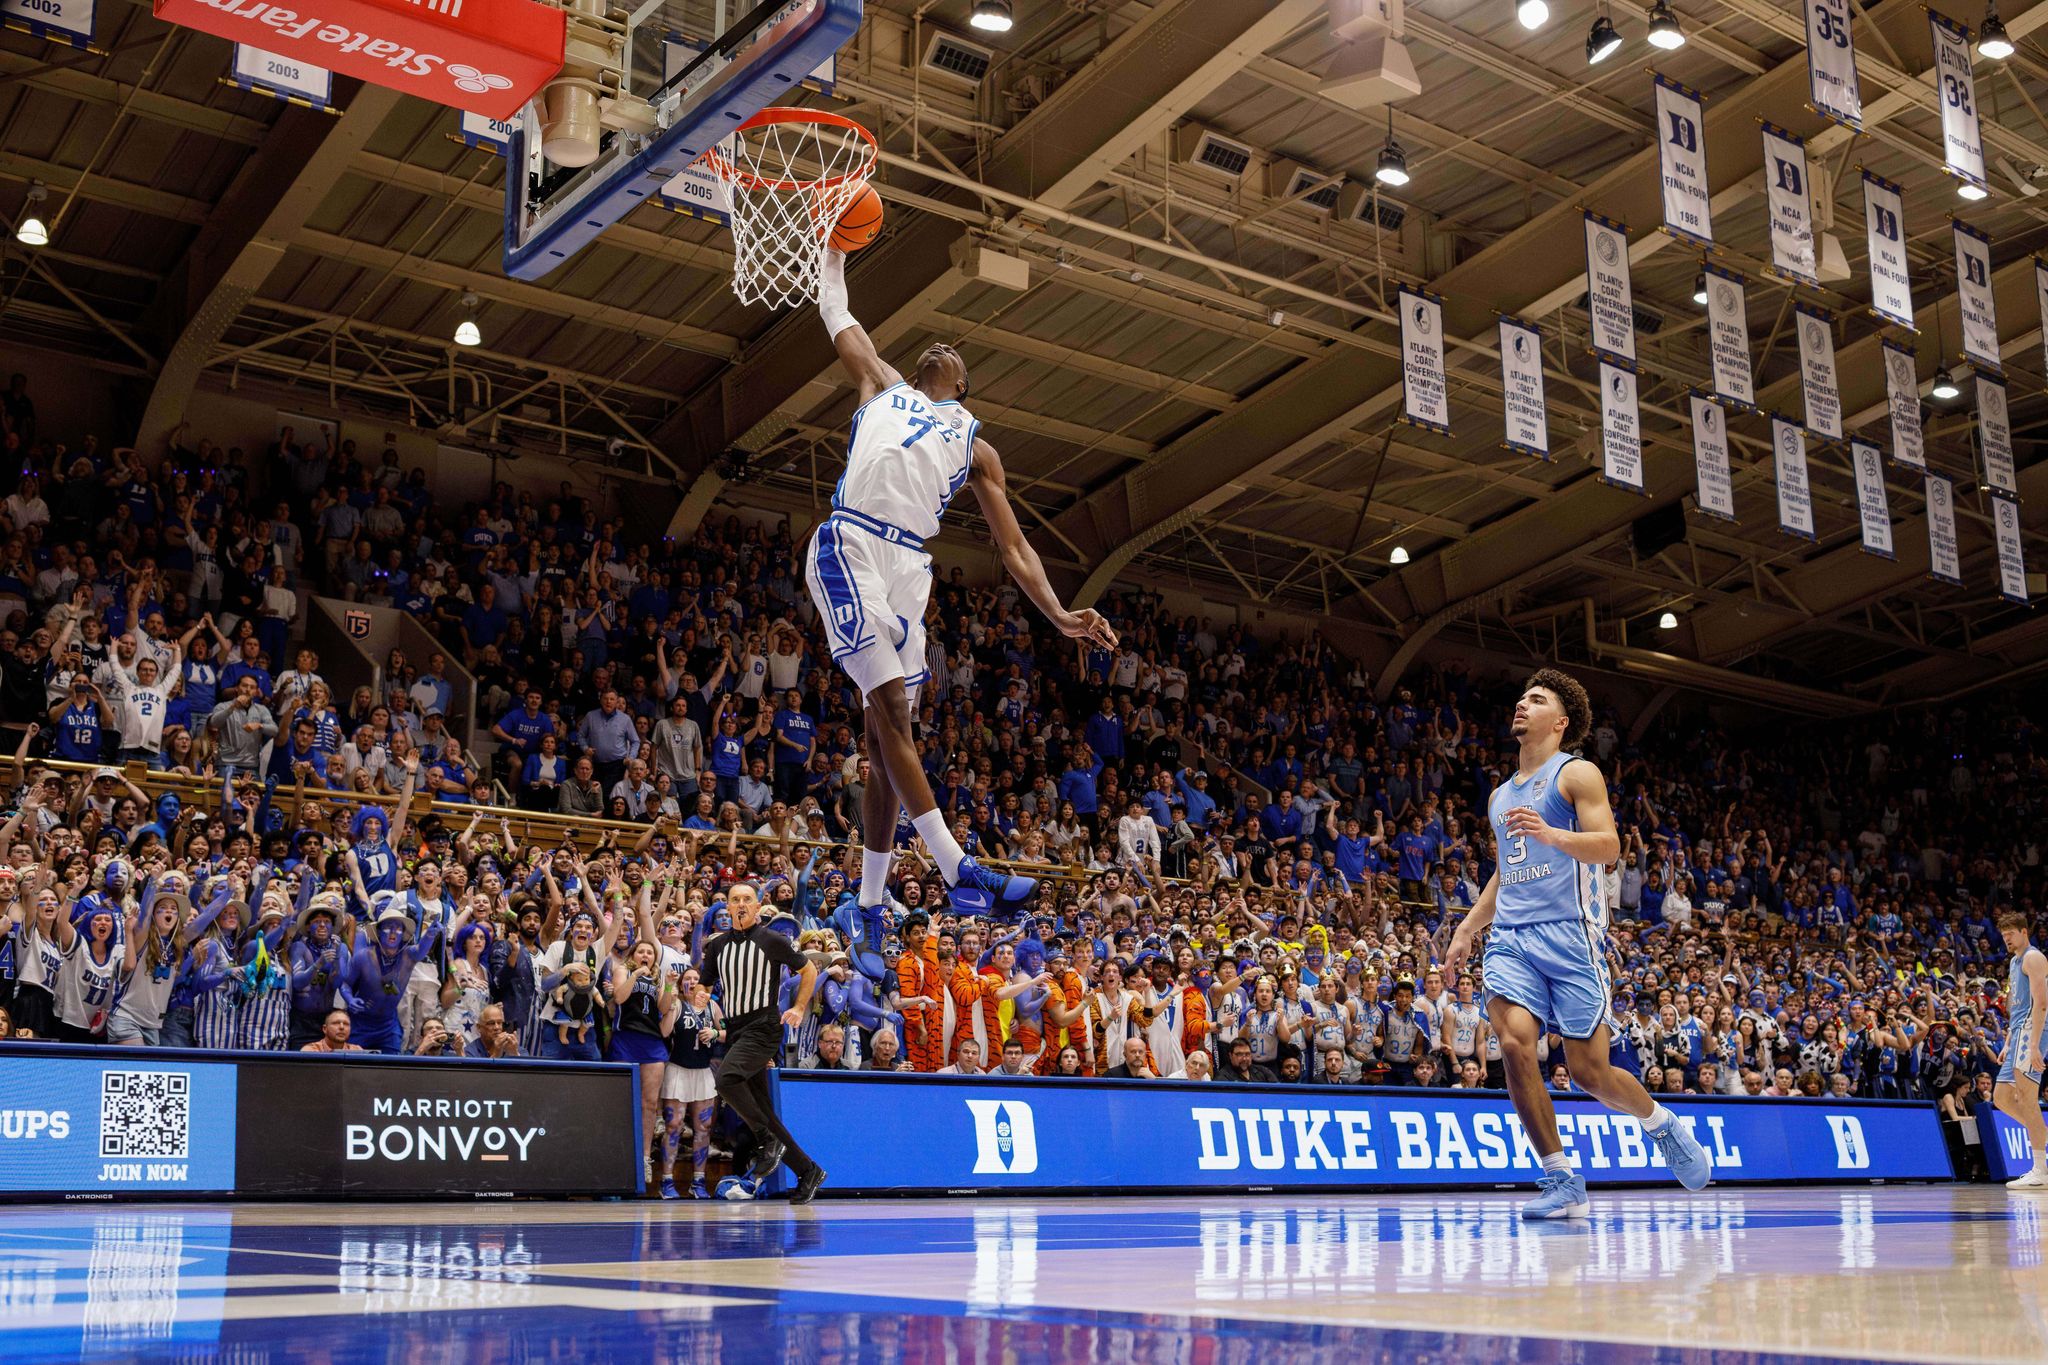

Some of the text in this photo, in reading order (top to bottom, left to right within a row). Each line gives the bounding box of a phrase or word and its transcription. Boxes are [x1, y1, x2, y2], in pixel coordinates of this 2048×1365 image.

[20, 0, 62, 17] 2002
[1815, 4, 1848, 48] 35
[268, 61, 300, 80] 2003
[1944, 74, 1972, 116] 32
[489, 118, 519, 136] 200
[1667, 110, 1696, 152] D
[1676, 162, 1696, 178] NCAA
[1773, 156, 1802, 195] D
[684, 182, 712, 200] 2005
[1665, 176, 1707, 201] FINAL FOUR
[1680, 210, 1698, 226] 1988
[1782, 206, 1802, 220] NCAA
[1774, 218, 1812, 240] FINAL OUR
[1873, 202, 1898, 242] D
[1882, 250, 1898, 266] NCAA
[1874, 264, 1890, 278] FINAL
[1963, 250, 1986, 288] D
[1596, 272, 1624, 290] ATLANTIC
[1602, 285, 1620, 300] COAST
[1593, 292, 1632, 315] CONFERENCE
[1971, 297, 1986, 311] NCAA
[1596, 305, 1630, 326] CHAMPIONS
[1964, 310, 1981, 324] FINAL
[1716, 322, 1742, 338] ATLANTIC
[1722, 334, 1740, 346] COAST
[1410, 342, 1437, 358] ATLANTIC
[1714, 342, 1750, 361] CONFERENCE
[1415, 355, 1434, 368] COAST
[1716, 354, 1749, 372] CHAMPIONS
[1808, 360, 1830, 374] ATLANTIC
[1406, 362, 1444, 382] CONFERENCE
[1510, 371, 1537, 386] ATLANTIC
[1812, 371, 1828, 384] COAST
[1409, 375, 1444, 393] CHAMPIONS
[1516, 382, 1534, 395] COAST
[1805, 379, 1840, 398] CONFERENCE
[1506, 390, 1543, 410] CONFERENCE
[1808, 391, 1838, 408] CHAMPIONS
[891, 394, 961, 443] DUKE
[1508, 403, 1542, 420] CHAMPIONS
[1608, 409, 1633, 424] ATLANTIC
[902, 416, 932, 448] 7
[1614, 420, 1630, 434] COAST
[1604, 429, 1640, 448] CONFERENCE
[1606, 440, 1639, 457] CHAMPIONS
[350, 617, 367, 632] 15
[132, 692, 161, 705] DUKE
[142, 702, 152, 716] 2
[68, 714, 98, 727] DUKE
[518, 724, 540, 734] DUKE
[789, 719, 810, 730] DUKE
[74, 728, 92, 744] 12
[1136, 840, 1144, 853] 2
[1506, 828, 1527, 865] 3
[1500, 863, 1552, 886] AROLINA
[1704, 902, 1724, 910] DUKE
[642, 994, 650, 1014] 1
[1458, 1030, 1472, 1042] 25
[1681, 1028, 1698, 1036] UKE
[1390, 1040, 1411, 1055] 32
[1622, 1040, 1626, 1052] 1
[374, 1098, 512, 1118] MARRIOTT
[0, 1110, 70, 1138] UPS
[965, 1100, 1038, 1174] D
[1191, 1108, 1742, 1170] DUKE BASKETBLL
[1824, 1116, 1870, 1168] D
[98, 1164, 188, 1182] JOIN NOW
